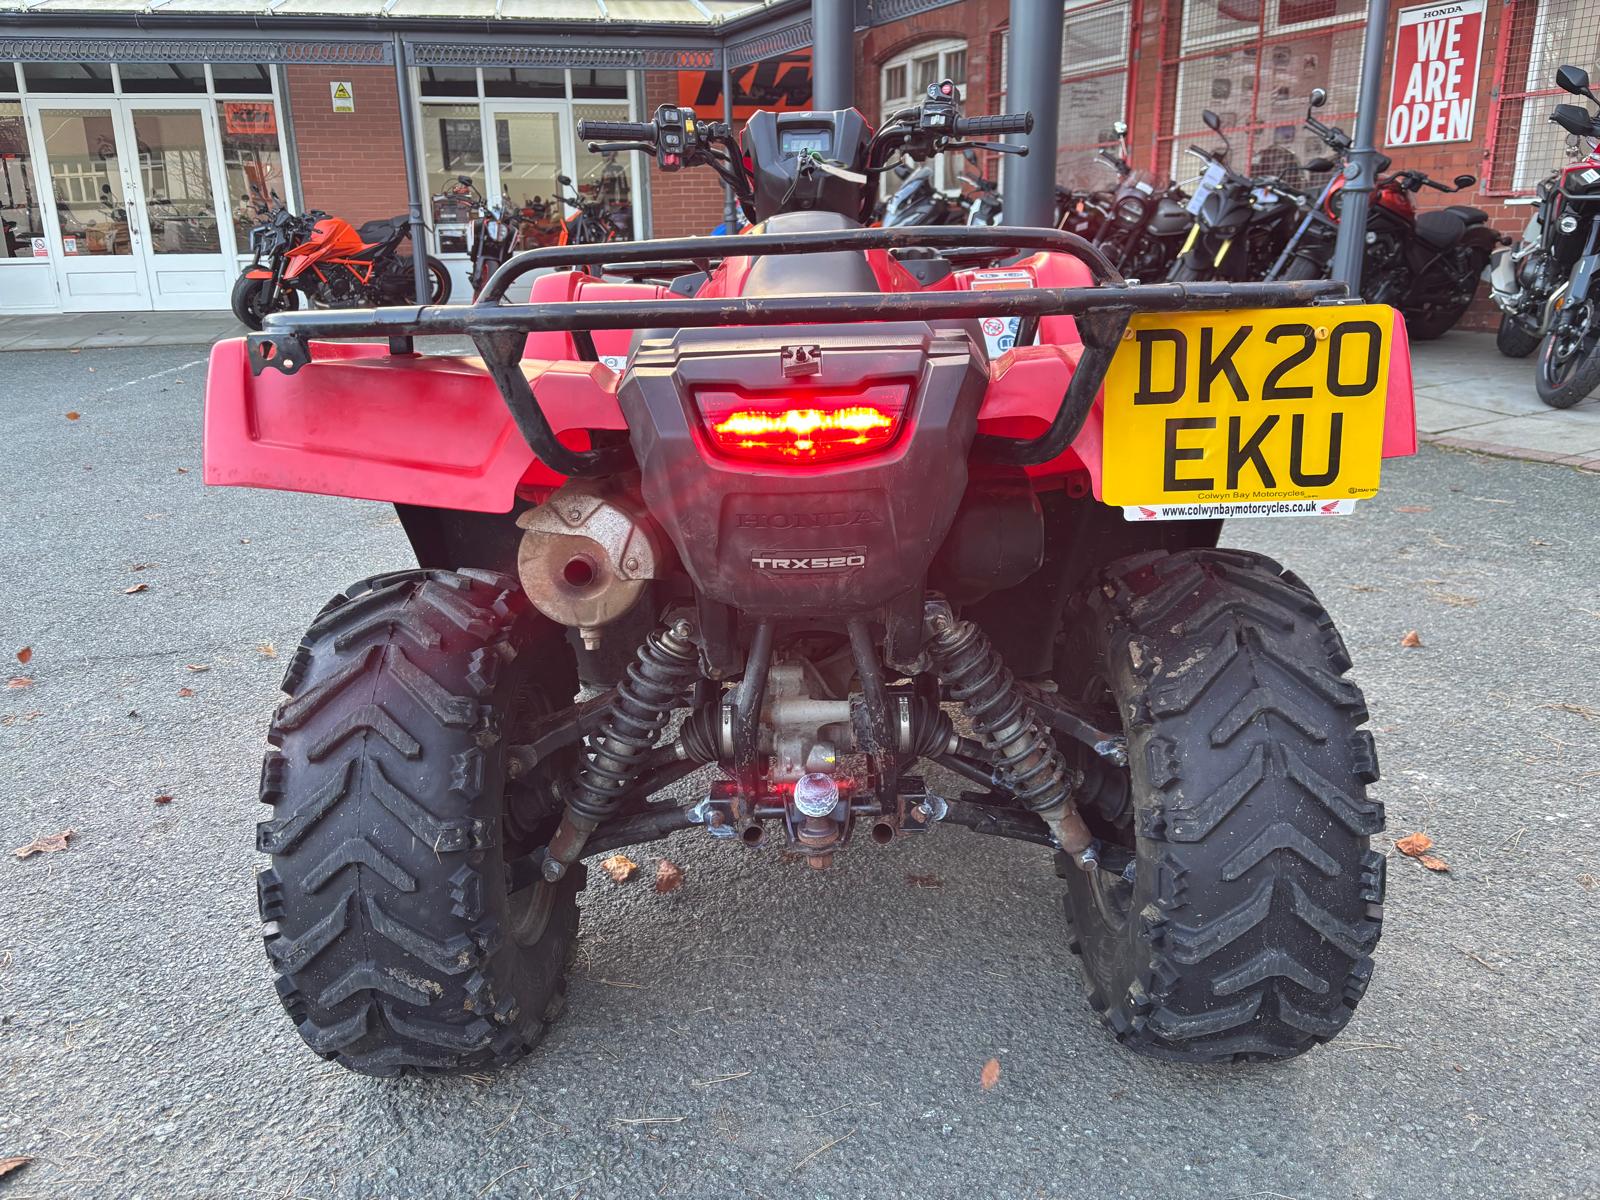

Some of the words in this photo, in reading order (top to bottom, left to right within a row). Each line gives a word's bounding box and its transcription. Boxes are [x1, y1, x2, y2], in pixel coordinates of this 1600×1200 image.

[1423, 6, 1463, 19] HONDA
[1417, 16, 1464, 62] WE
[1403, 58, 1465, 104] ARE
[1389, 98, 1471, 145] OPEN
[1134, 320, 1382, 405] DK20
[1163, 412, 1344, 492] EKU
[1162, 501, 1317, 517] www.colwynbaymotorcycles.co.uk
[1198, 492, 1230, 500] Colwyn
[1252, 490, 1305, 498] Motorcycles
[735, 510, 883, 529] HONDA
[752, 555, 865, 569] TRX520
